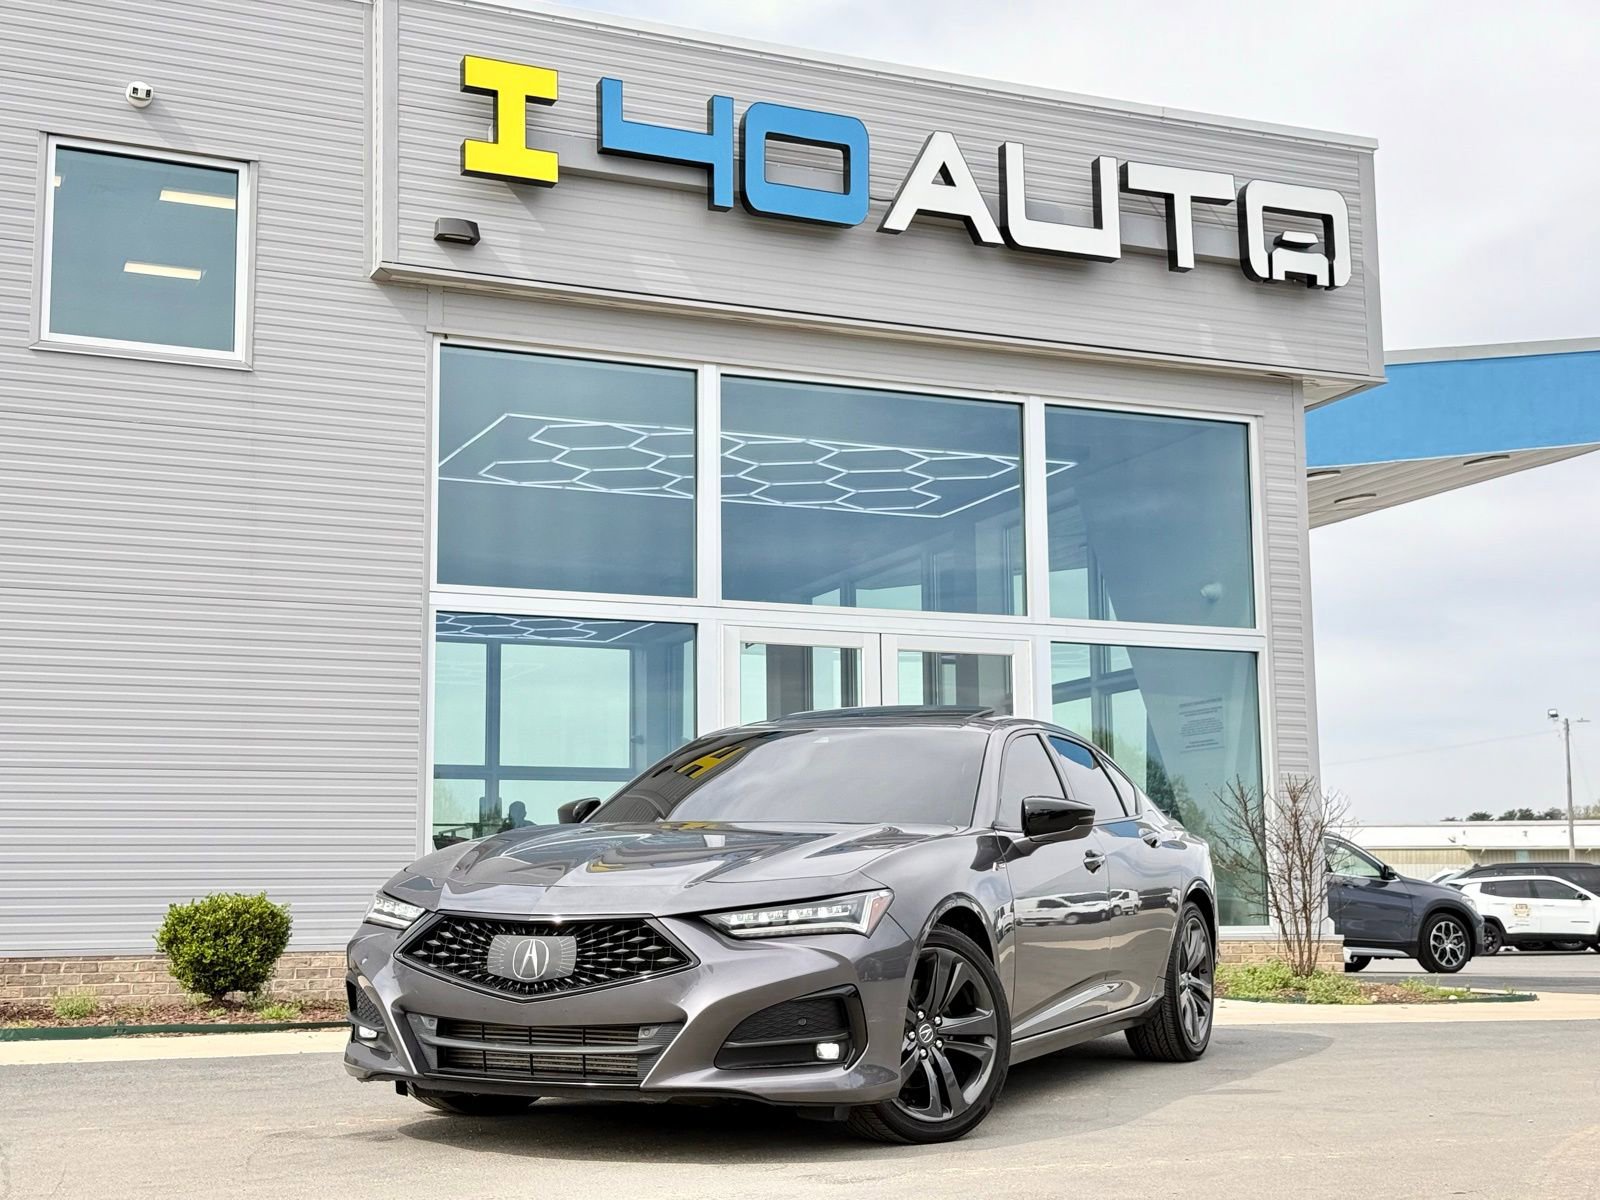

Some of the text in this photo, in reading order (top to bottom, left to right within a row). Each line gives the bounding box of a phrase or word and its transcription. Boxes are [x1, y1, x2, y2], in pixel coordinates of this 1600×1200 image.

[461, 55, 1352, 290] I 40 AUTO
